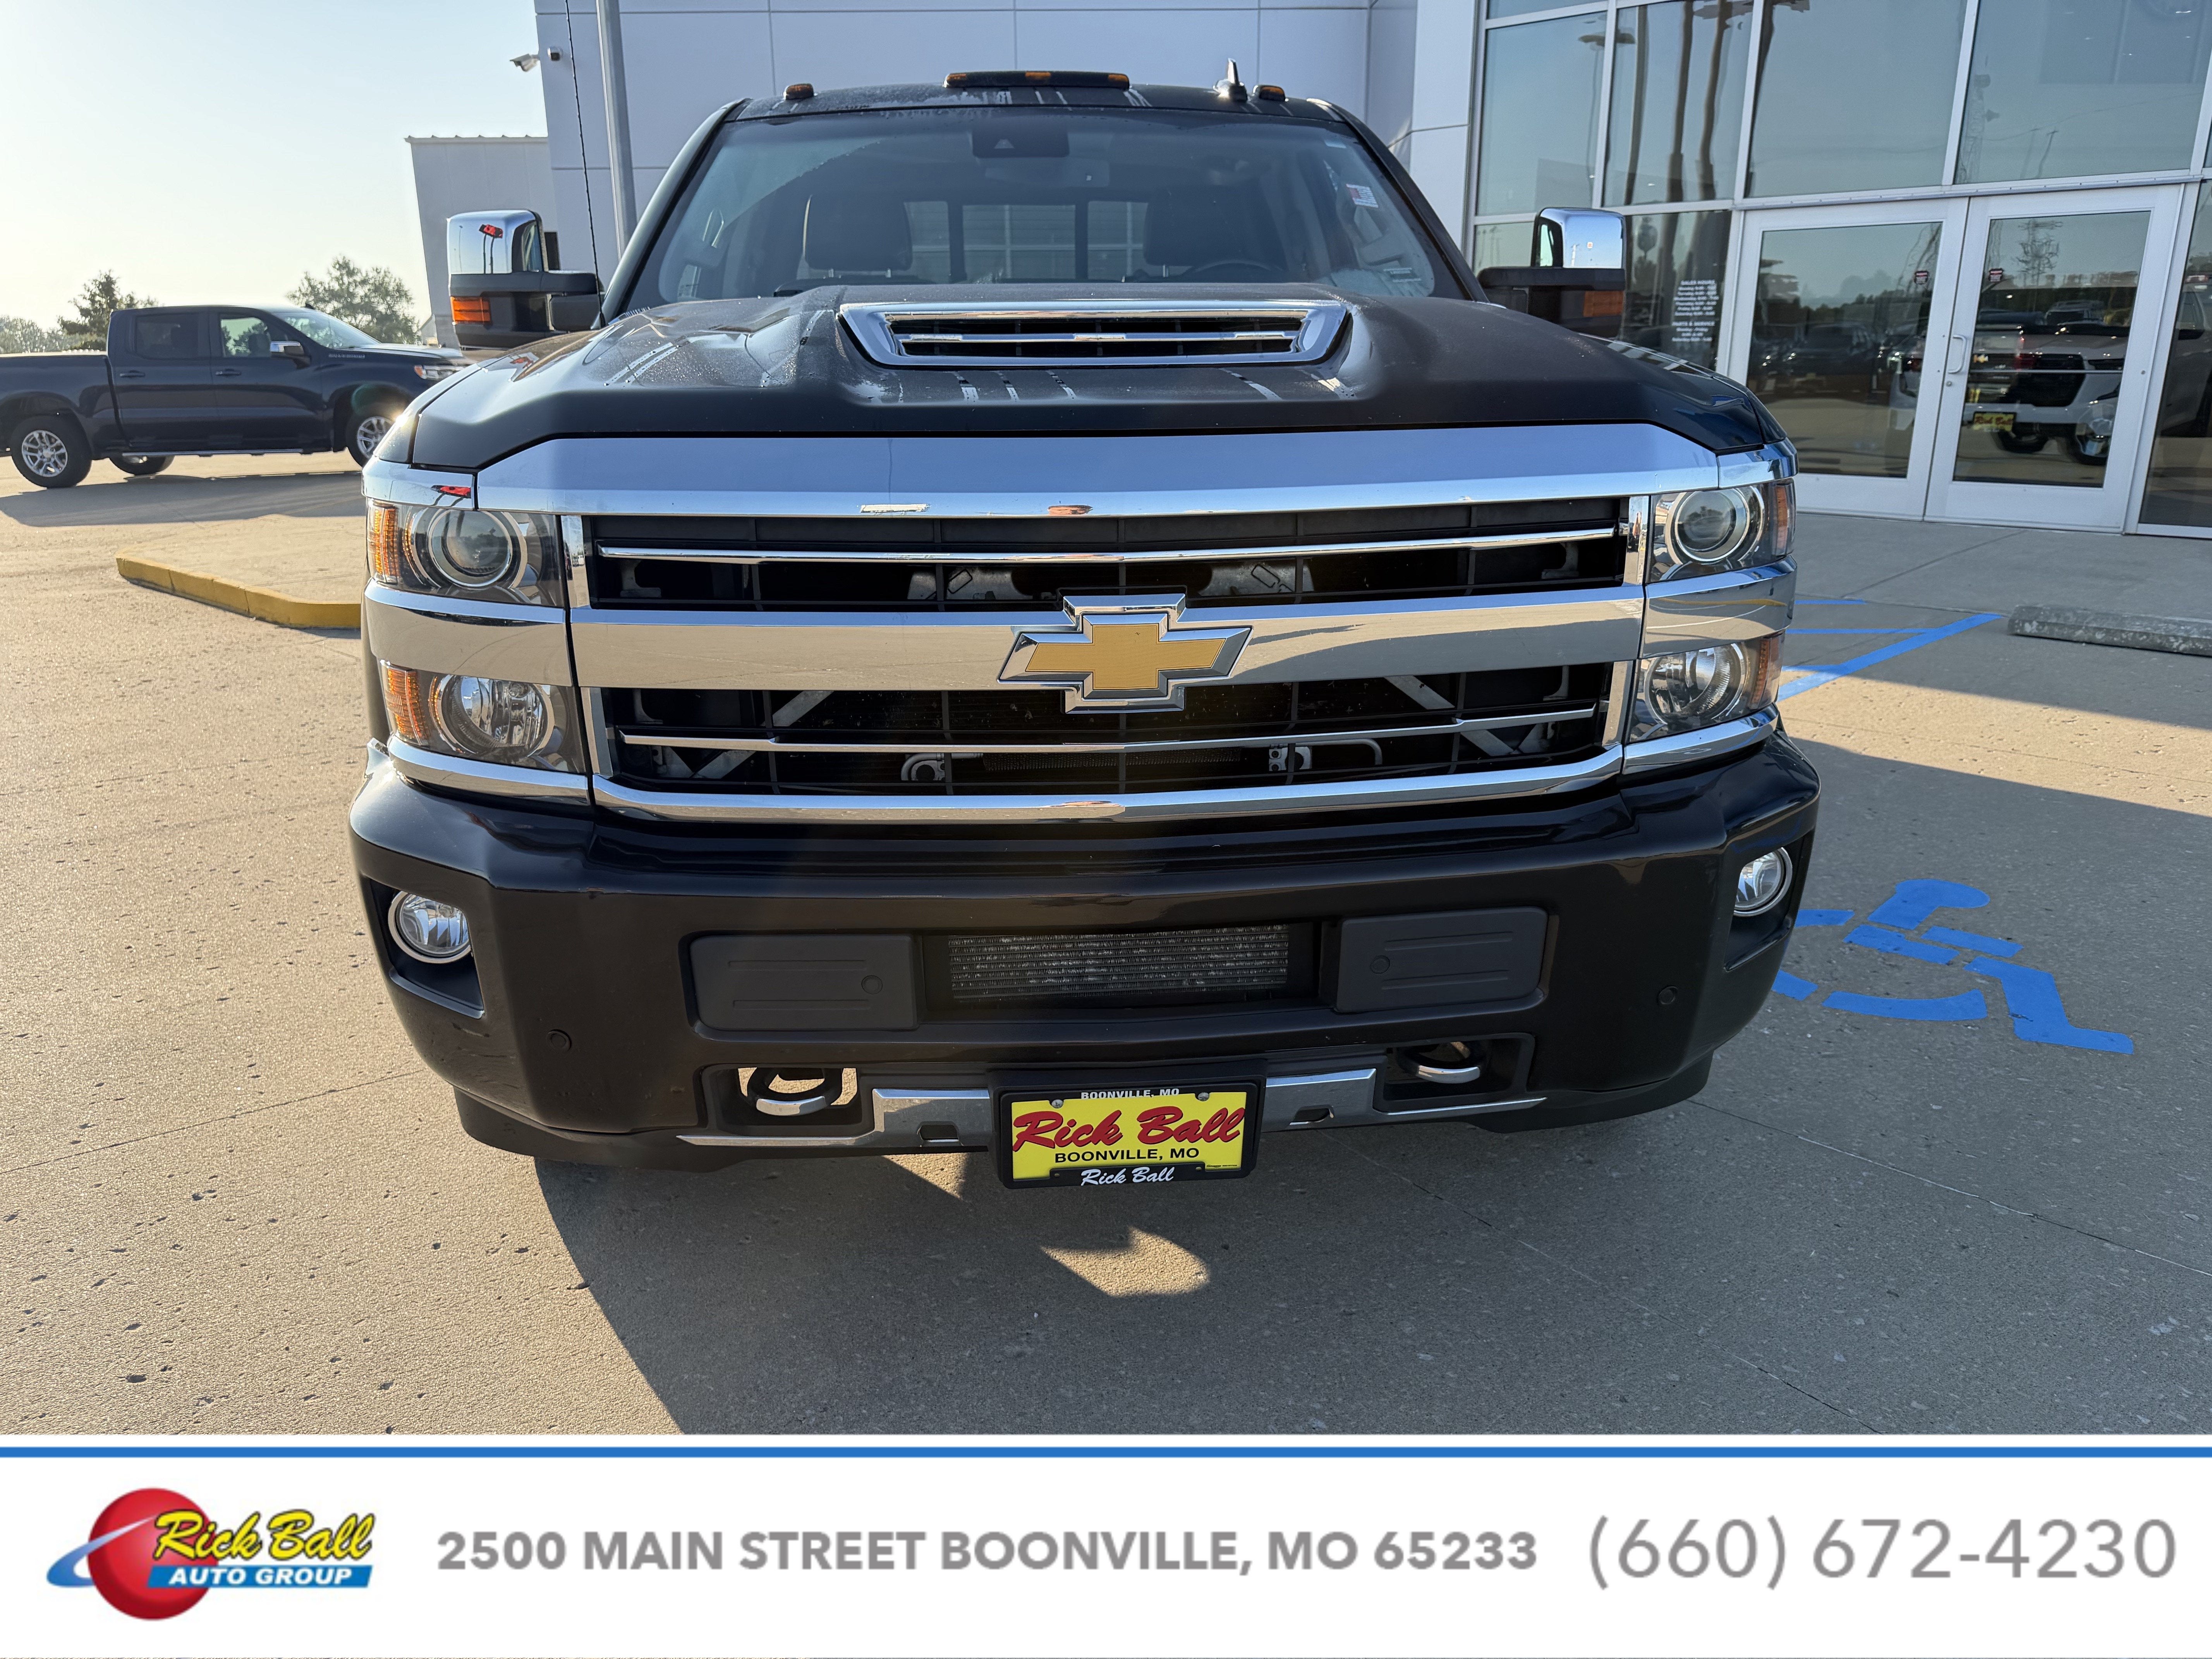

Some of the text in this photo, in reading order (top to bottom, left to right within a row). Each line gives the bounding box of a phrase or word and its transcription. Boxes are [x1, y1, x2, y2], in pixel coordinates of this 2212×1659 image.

[1081, 1090, 1154, 1099] BOONVILLE,
[1013, 1106, 1245, 1151] Rick Ball
[1055, 1147, 1199, 1163] BOONVILLE, MO
[1080, 1167, 1174, 1186] Rick Ball
